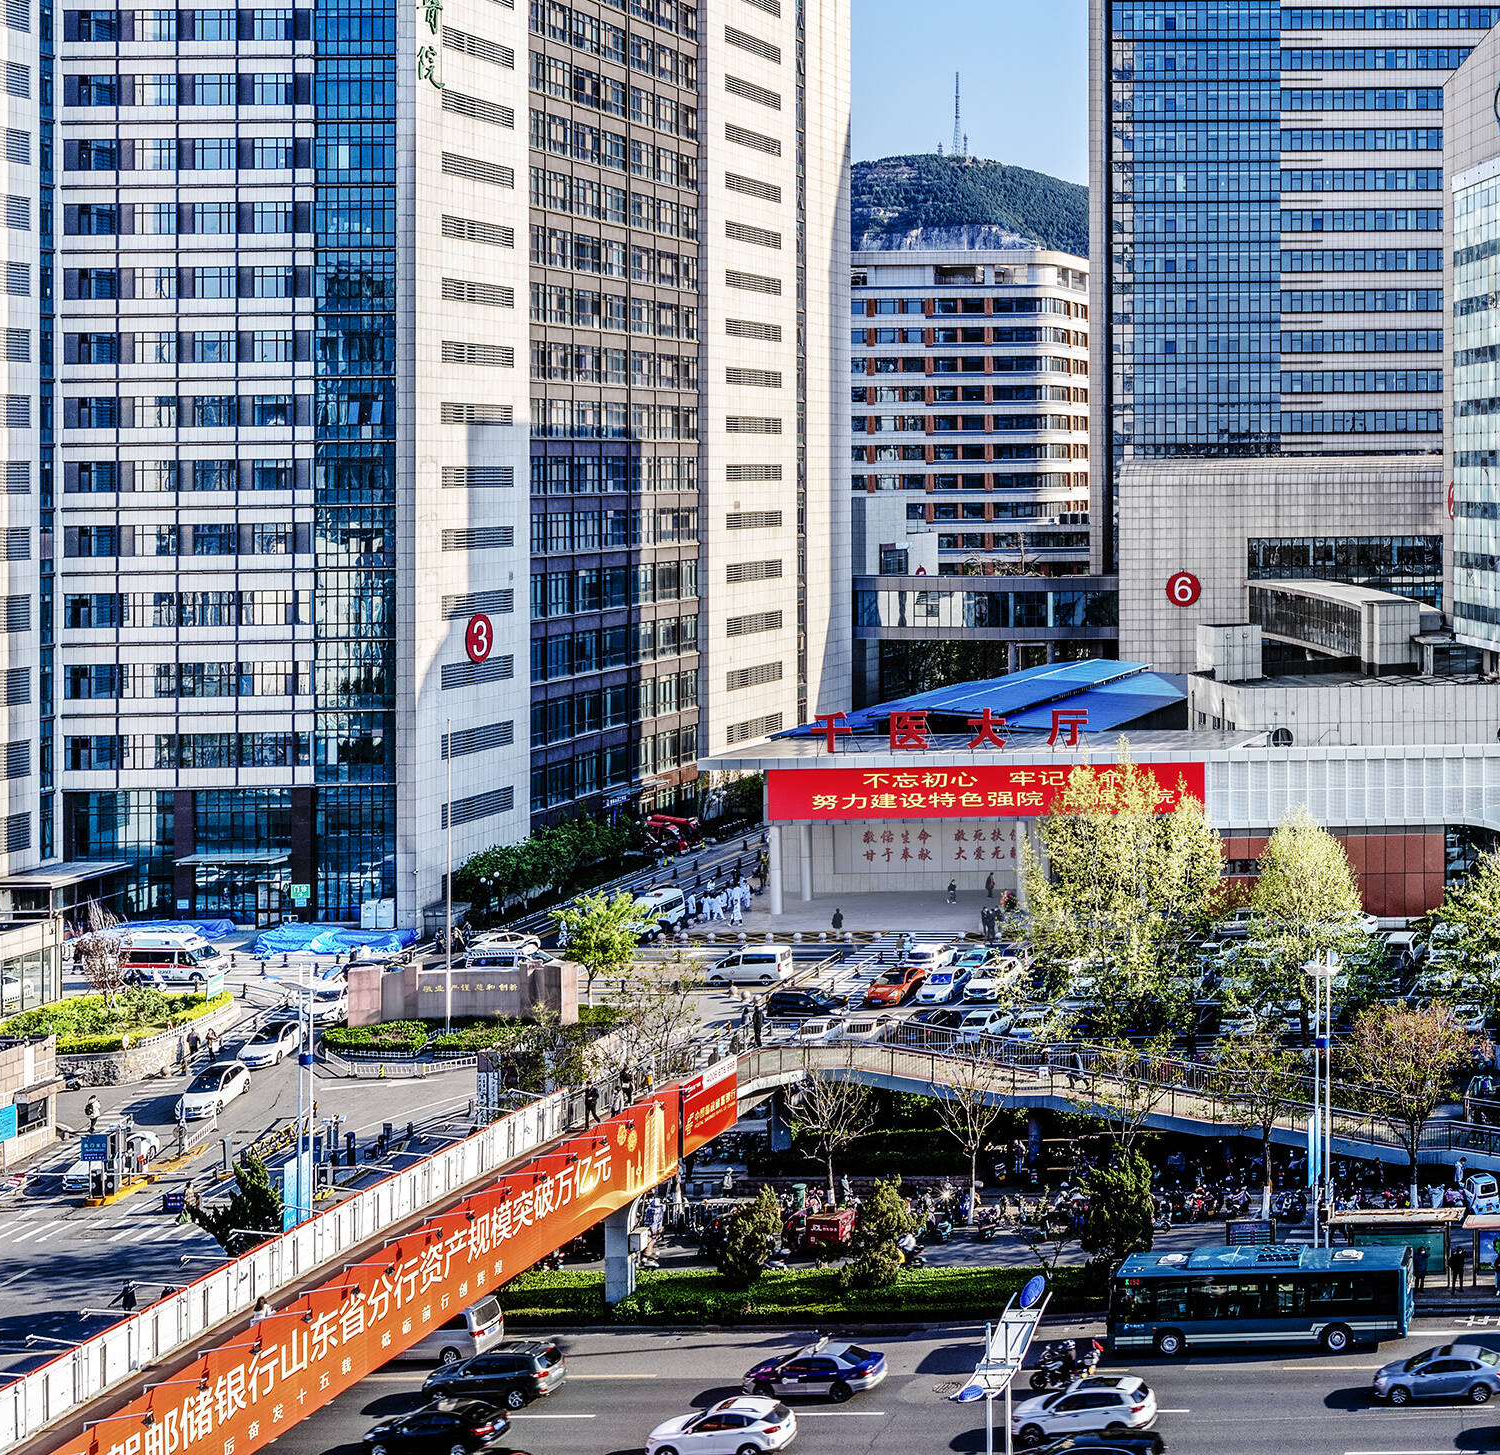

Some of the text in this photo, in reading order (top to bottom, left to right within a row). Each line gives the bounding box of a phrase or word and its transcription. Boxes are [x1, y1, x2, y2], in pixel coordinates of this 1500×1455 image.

[1172, 576, 1194, 603] 6
[473, 621, 488, 656] 3
[811, 708, 1088, 753] 千医大厅
[863, 771, 978, 789] 不忘初心
[812, 790, 1045, 811] 努力建设特色强院
[863, 828, 932, 844] 敬佑生命
[863, 846, 932, 862] 甘于奉献
[381, 1259, 503, 1349] 砥砺前行创辉煌
